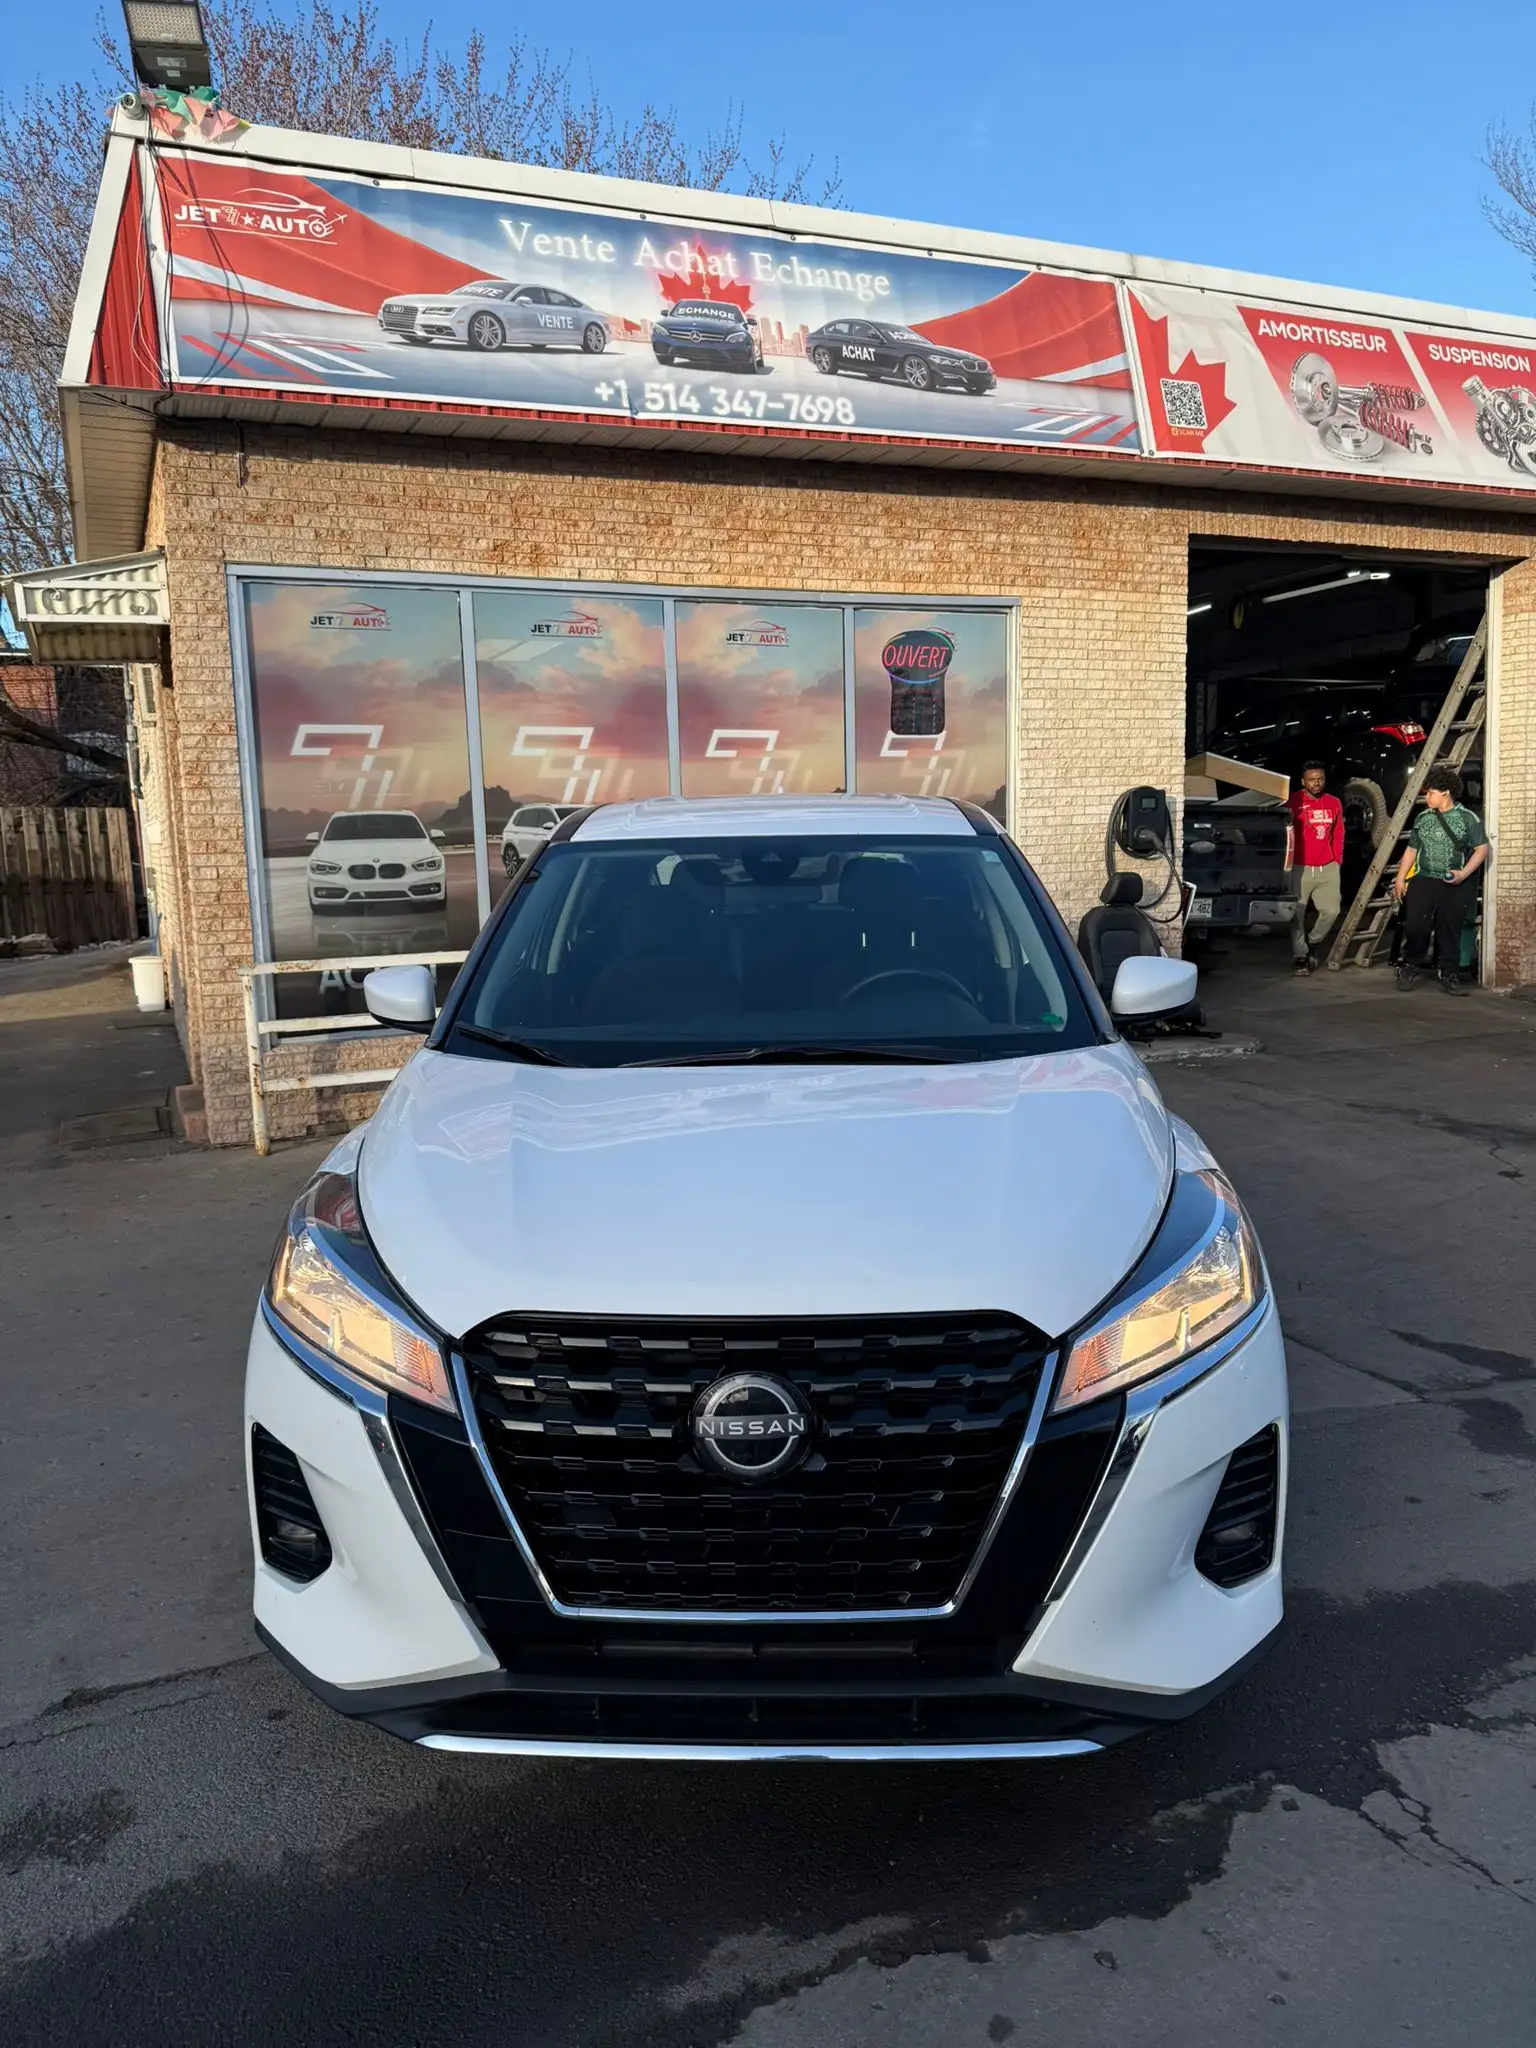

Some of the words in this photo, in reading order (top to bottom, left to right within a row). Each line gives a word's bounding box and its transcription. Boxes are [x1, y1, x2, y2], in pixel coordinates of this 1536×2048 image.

[259, 214, 328, 238] AUTO
[499, 218, 615, 263] Vente
[634, 238, 737, 279] Achat
[752, 252, 891, 301] Echange
[537, 313, 574, 330] VENTE
[678, 306, 736, 320] ECHANGE
[1258, 318, 1388, 353] AMORTISSEUR
[842, 344, 876, 362] ACHAT
[1428, 343, 1531, 373] SUSPENSION
[594, 379, 629, 409] +1
[644, 382, 700, 413] 514
[709, 385, 856, 425] 347-7698
[883, 644, 949, 669] OUVERT
[699, 1417, 805, 1436] NISSAN
